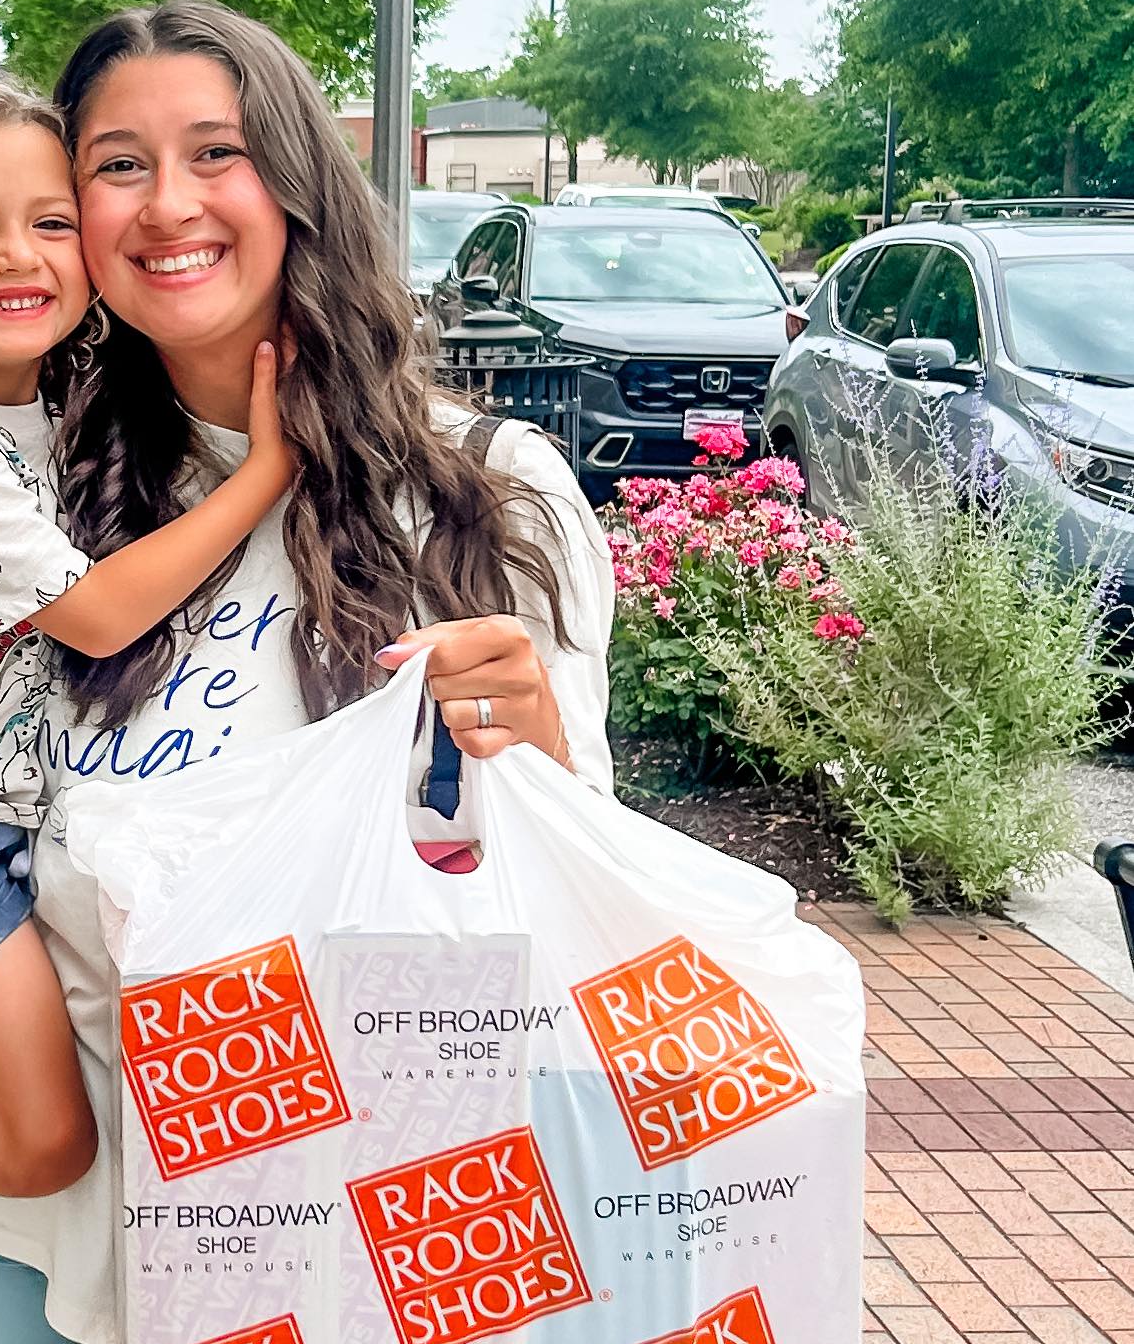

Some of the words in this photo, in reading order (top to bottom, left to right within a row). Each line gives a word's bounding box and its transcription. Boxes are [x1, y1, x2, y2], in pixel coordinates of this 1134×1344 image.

[163, 652, 260, 711] re
[128, 959, 285, 1047] RACK
[353, 1011, 413, 1035] OFF
[597, 947, 725, 1037] RACK
[136, 1011, 317, 1108] ROOM
[438, 1041, 501, 1060] SHOE
[614, 991, 767, 1098] ROOM
[158, 1068, 335, 1164] SHOES
[638, 1045, 798, 1154] SHOES
[176, 1202, 335, 1228] BROADWAY
[373, 1144, 528, 1232] RACK
[593, 1193, 651, 1219] OFF
[657, 1175, 801, 1216] BROADWAY
[196, 1235, 257, 1255] SHOE
[380, 1194, 557, 1291] ROOM
[621, 1233, 778, 1263] WAREHOUSE
[676, 1215, 728, 1242] SHOE
[141, 1259, 313, 1274] WAREHOUSE
[402, 1250, 574, 1344] SHOES
